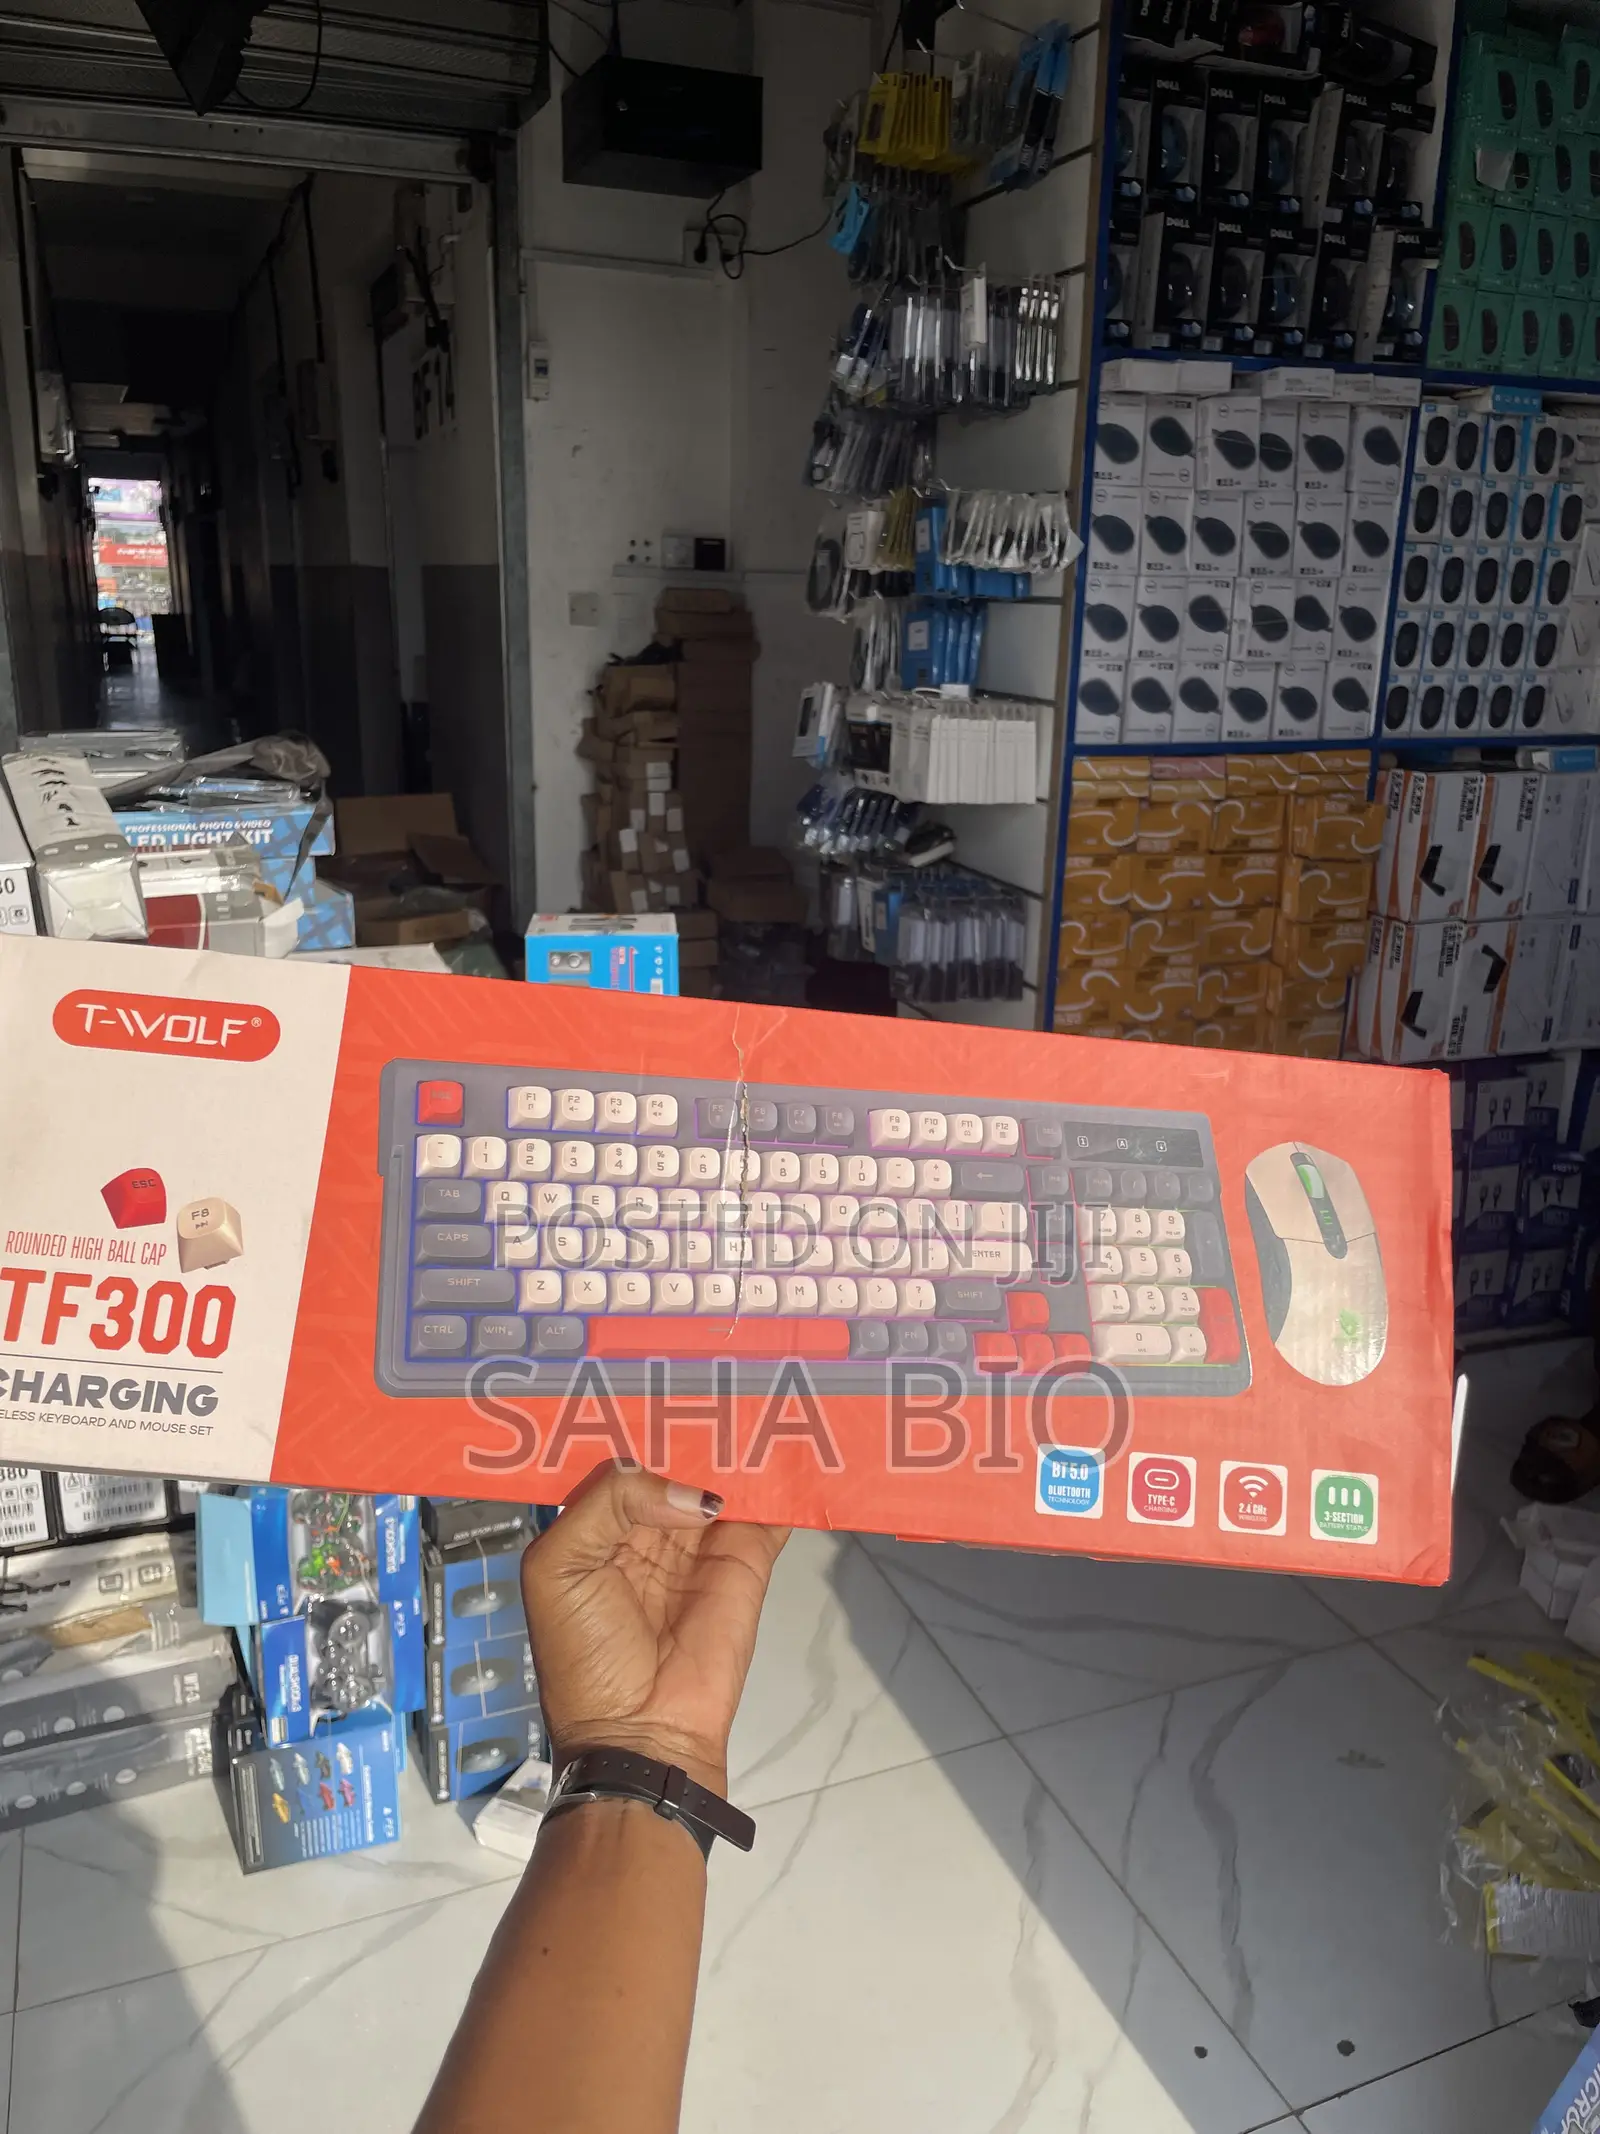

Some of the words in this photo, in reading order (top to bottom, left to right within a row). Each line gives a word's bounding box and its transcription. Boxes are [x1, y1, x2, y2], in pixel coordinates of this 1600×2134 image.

[1156, 78, 1181, 92] DELL
[1210, 87, 1234, 99] DELL
[1263, 93, 1288, 105] DELL
[1345, 92, 1367, 106] DELL
[1390, 102, 1413, 114] DELL
[1166, 216, 1191, 229] DELL
[1218, 221, 1244, 234] DELL
[1270, 227, 1294, 240] DELL
[1324, 233, 1347, 246] DELL
[1397, 233, 1421, 245] DELL
[125, 822, 198, 833] PROFESSIONAL
[200, 820, 233, 831] PHOTO
[240, 828, 274, 845] KIT
[526, 1092, 536, 1101] F1
[568, 1095, 580, 1104] F2
[610, 1098, 622, 1106] F3
[651, 1100, 664, 1109] F4
[890, 1115, 900, 1124] F9
[924, 1118, 938, 1126] F10
[961, 1120, 973, 1128] F11
[995, 1122, 1008, 1130] F12
[483, 1153, 489, 1163] 1
[526, 1155, 534, 1165] 2
[570, 1158, 578, 1167] 3
[614, 1160, 623, 1169] 4
[657, 1162, 665, 1171] 5
[700, 1164, 707, 1173] 6
[780, 1167, 787, 1176] 8
[819, 1169, 827, 1179] 9
[858, 1172, 865, 1181] 0
[131, 1178, 155, 1189] ESC
[438, 1188, 460, 1198] TAB
[501, 1191, 510, 1202] Q
[544, 1193, 558, 1203] W
[592, 1195, 599, 1205] E
[636, 1197, 644, 1207] R
[761, 1202, 769, 1211] U
[839, 1206, 847, 1215] O
[191, 1208, 209, 1221] F8
[877, 1207, 885, 1216] P
[1134, 1214, 1141, 1222] 8
[1168, 1216, 1175, 1224] 9
[437, 1233, 469, 1242] CAPS
[512, 1236, 522, 1244] A
[558, 1237, 566, 1246] S
[603, 1238, 611, 1247] D
[647, 1239, 653, 1248] F
[688, 1241, 696, 1250] G
[730, 1241, 737, 1251] H
[6, 1231, 67, 1257] ROUNDED
[71, 1236, 101, 1261] HIGH
[107, 1239, 136, 1265] BALL
[140, 1242, 167, 1266] CAP
[771, 1244, 777, 1252] J
[811, 1245, 819, 1254] K
[852, 1246, 860, 1255] L
[972, 1250, 1001, 1259] ENTER
[1105, 1252, 1112, 1261] 4
[1140, 1253, 1146, 1262] 5
[1174, 1254, 1181, 1263] 6
[447, 1277, 481, 1287] SHIFT
[537, 1281, 545, 1290] Z
[583, 1282, 592, 1291] X
[627, 1282, 635, 1292] C
[669, 1283, 679, 1292] V
[713, 1284, 721, 1294] B
[754, 1285, 763, 1294] N
[795, 1286, 804, 1296] M
[957, 1290, 983, 1299] SHIFT
[1112, 1290, 1118, 1299] 1
[1147, 1291, 1154, 1300] 2
[1181, 1292, 1188, 1301] 3
[0, 1267, 237, 1359] TF300
[424, 1325, 453, 1334] CTRL
[484, 1326, 507, 1334] WIN
[545, 1326, 566, 1335] ALT
[905, 1331, 917, 1339] FN
[1135, 1332, 1143, 1341] 0
[38, 1412, 107, 1428] KEYBOARD
[109, 1417, 137, 1430] AND
[139, 1420, 186, 1434] MOUSE
[189, 1424, 214, 1436] SET
[1052, 1461, 1069, 1480] BT
[1070, 1463, 1088, 1481] 5.0
[1048, 1485, 1091, 1499] BLUETOOTH
[1048, 1496, 1090, 1505] TECHNOLOGY
[1147, 1494, 1175, 1507] TYPE-C
[1144, 1504, 1178, 1514] CHARGING
[1324, 1511, 1364, 1525] 3-SECTION
[1319, 1522, 1344, 1531] BATTERY
